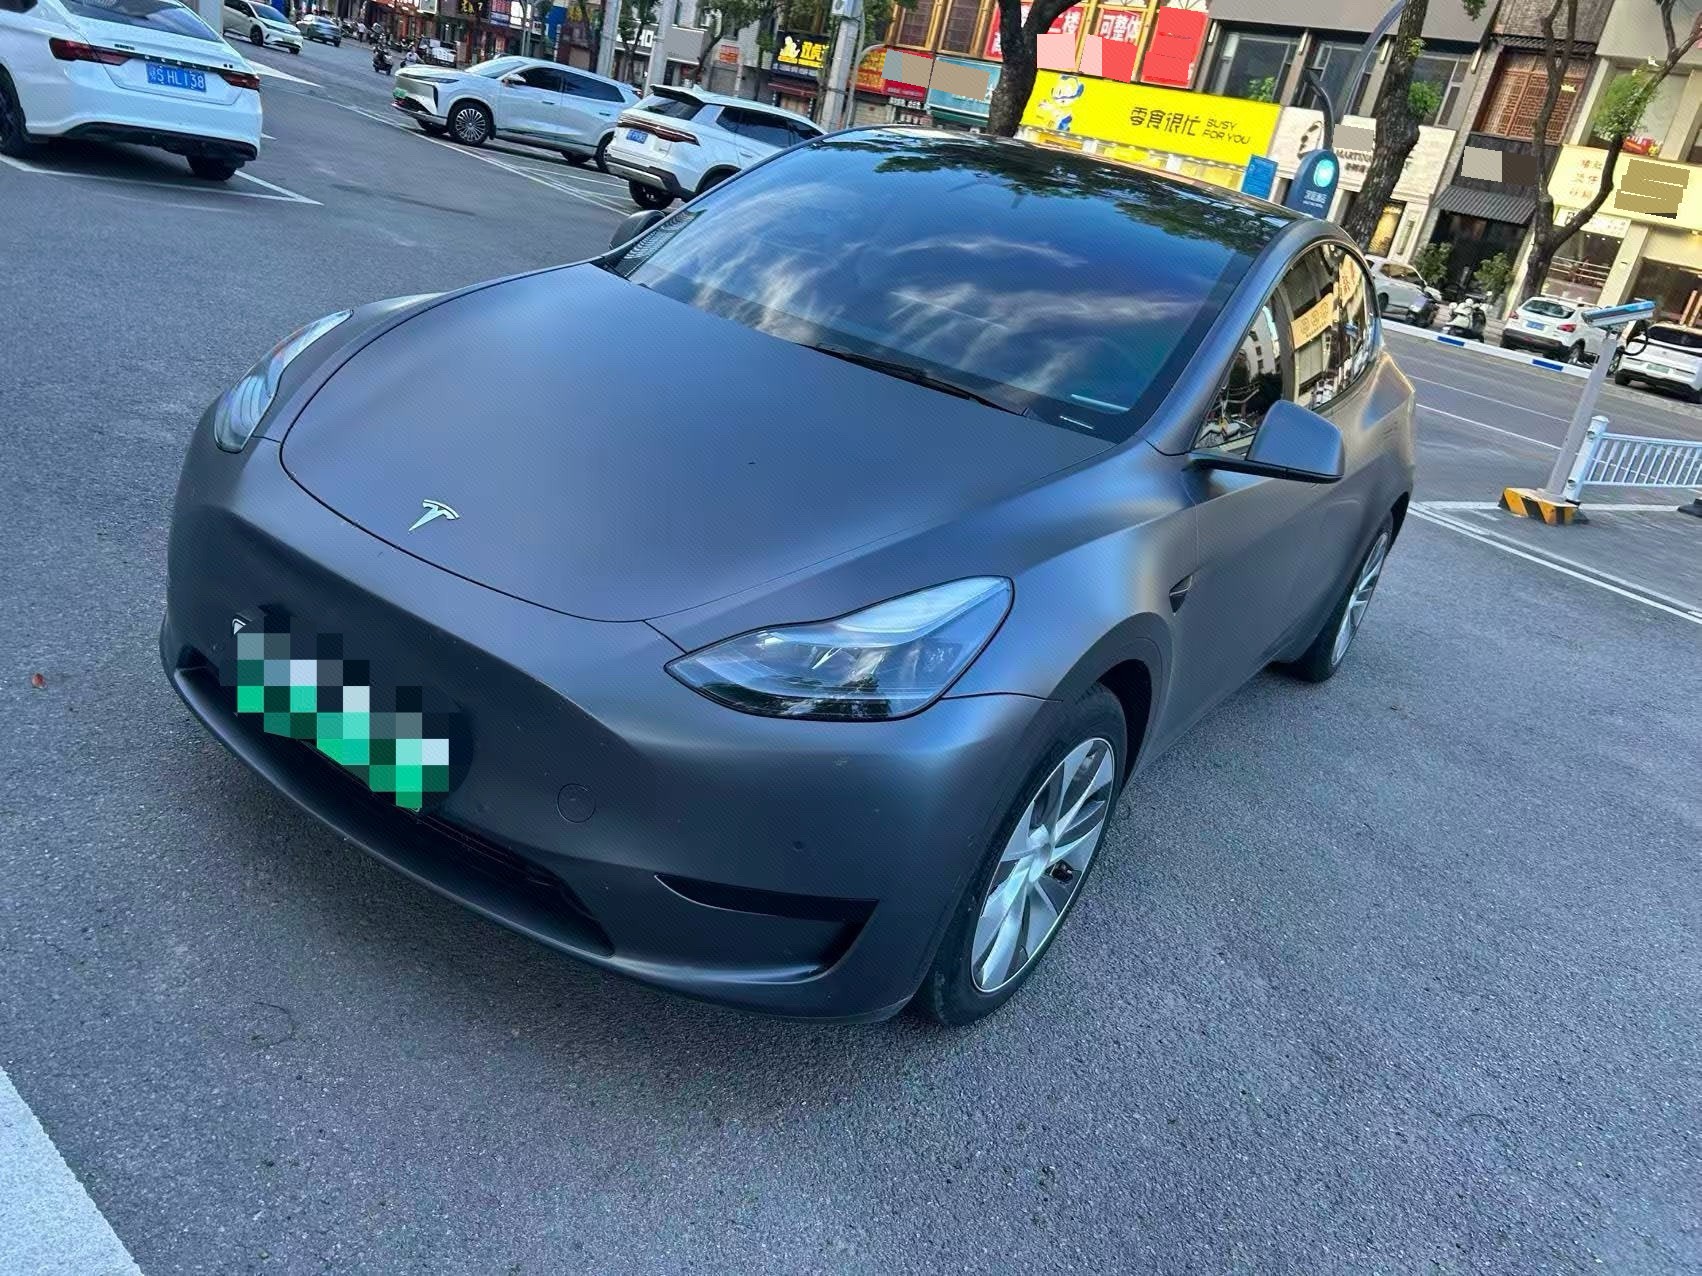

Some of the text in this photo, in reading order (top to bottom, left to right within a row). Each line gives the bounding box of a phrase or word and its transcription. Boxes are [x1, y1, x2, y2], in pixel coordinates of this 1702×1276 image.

[1130, 106, 1201, 137] 零食很忙
[1206, 118, 1238, 131] BUSY
[1202, 129, 1251, 145] FOR YOU
